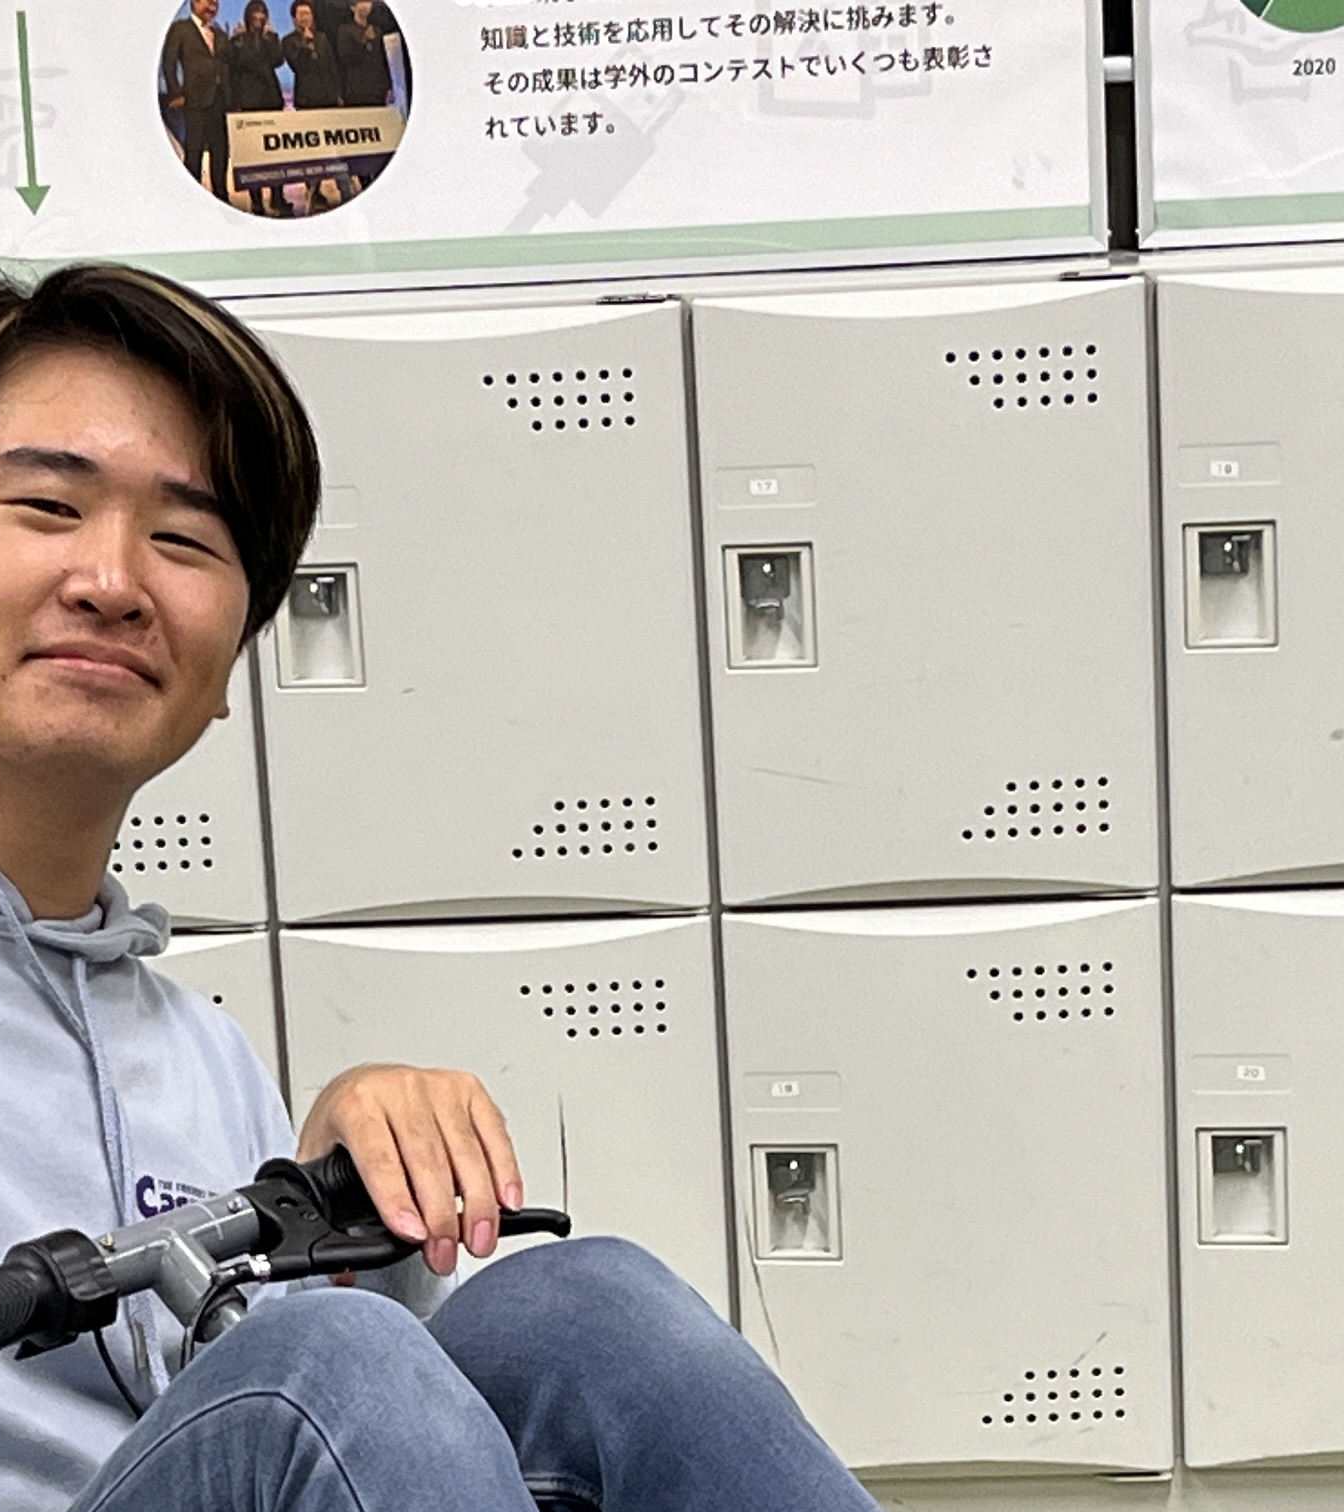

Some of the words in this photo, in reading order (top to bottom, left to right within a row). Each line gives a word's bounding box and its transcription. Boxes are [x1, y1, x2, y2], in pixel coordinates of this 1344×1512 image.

[1292, 57, 1336, 77] 2020
[262, 130, 321, 151] DMG
[323, 126, 382, 147] MORI
[485, 112, 615, 140] れています。
